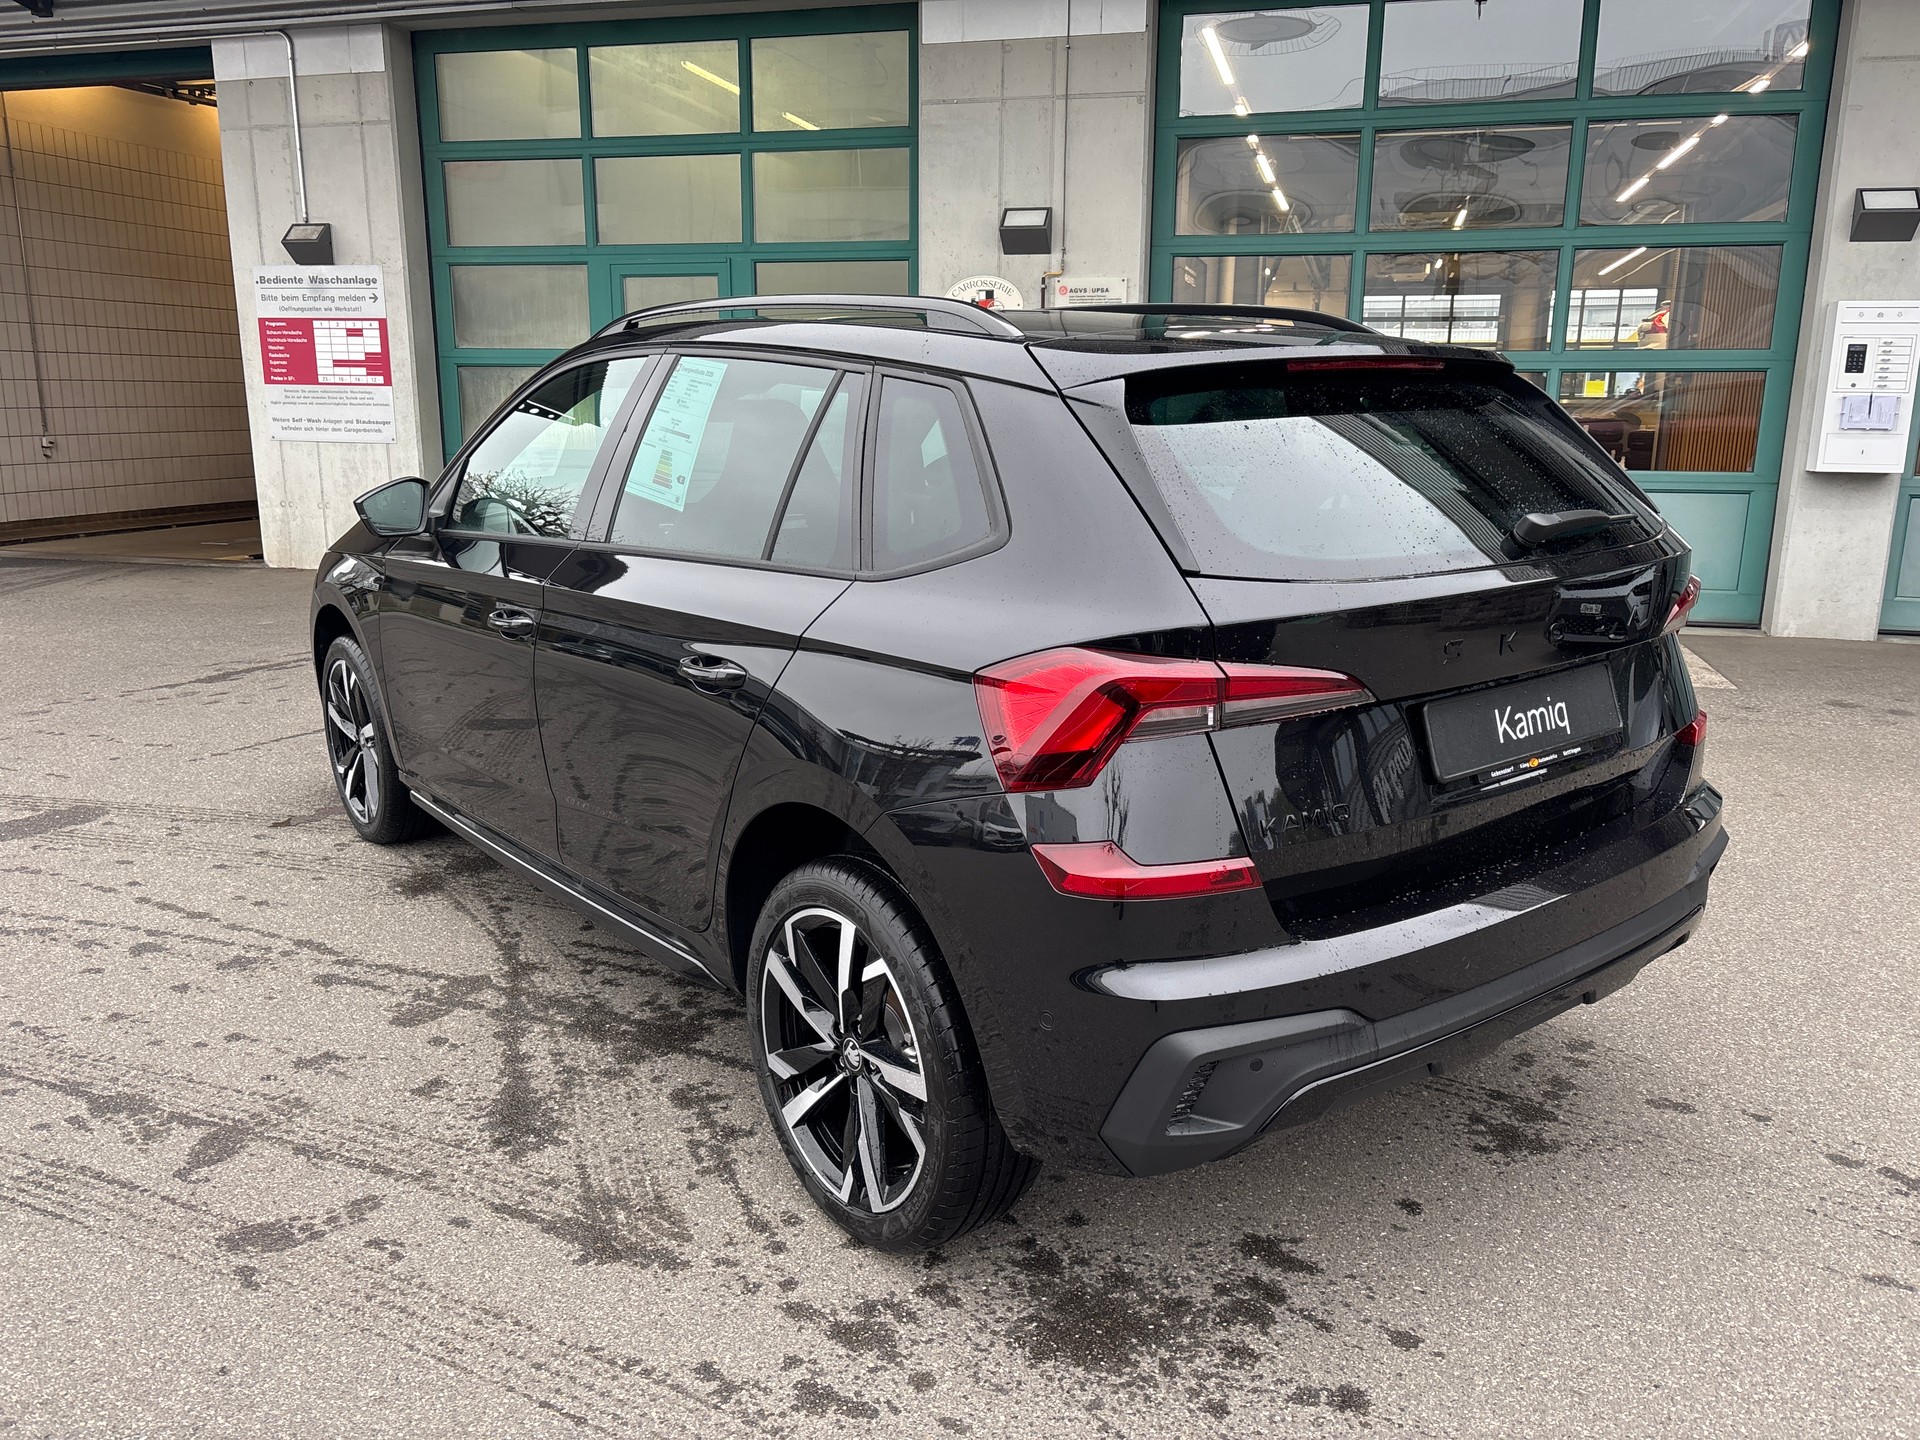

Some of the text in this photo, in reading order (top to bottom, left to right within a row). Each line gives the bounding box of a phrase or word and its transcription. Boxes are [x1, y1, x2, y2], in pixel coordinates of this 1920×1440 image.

[259, 275, 378, 286] Bediente Waschanlage
[951, 279, 1015, 298] CARROSSERIE
[260, 293, 366, 303] Bitte beim Empfang melden
[356, 419, 392, 427] Staubsauger
[1494, 696, 1571, 744] Kamiq
[1259, 803, 1350, 839] KAMIQ
